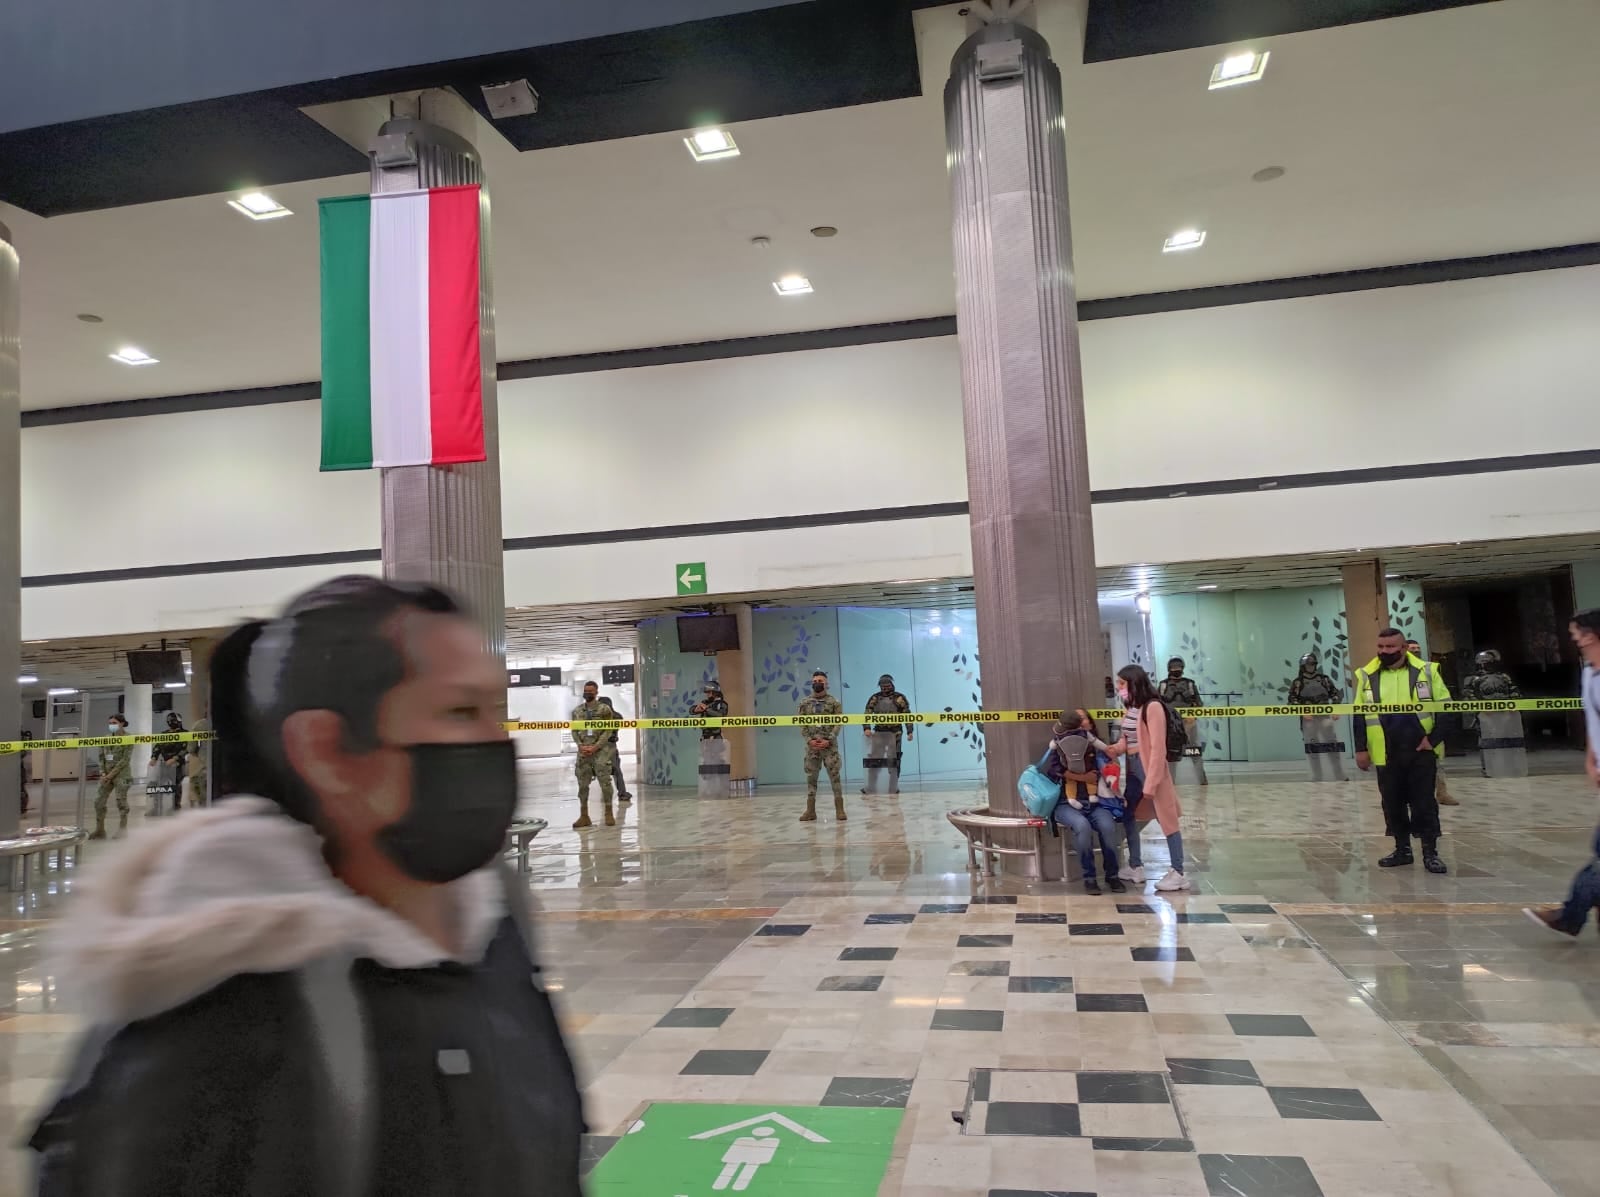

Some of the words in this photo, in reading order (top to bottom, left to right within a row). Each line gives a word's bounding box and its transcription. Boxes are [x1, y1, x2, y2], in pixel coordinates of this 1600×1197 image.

[584, 720, 637, 728] PROHIBIDO
[652, 719, 706, 727] PROHIBIDO
[721, 717, 777, 726] PROHIBIDO
[792, 716, 849, 724] PROHIBIDO
[864, 714, 923, 723] PROHIBIDO
[940, 713, 1000, 721] PROHIBIDO
[1180, 708, 1246, 717] PROHIBIDO
[1264, 706, 1334, 715] PROHIBIDO
[1353, 704, 1423, 712] PROHIBIDO
[1443, 701, 1516, 711] PROHIBIDO
[23, 740, 67, 749] PROHIBIDO
[78, 737, 123, 746] PROHIBIDO
[134, 734, 180, 743] PROHIBIDO
